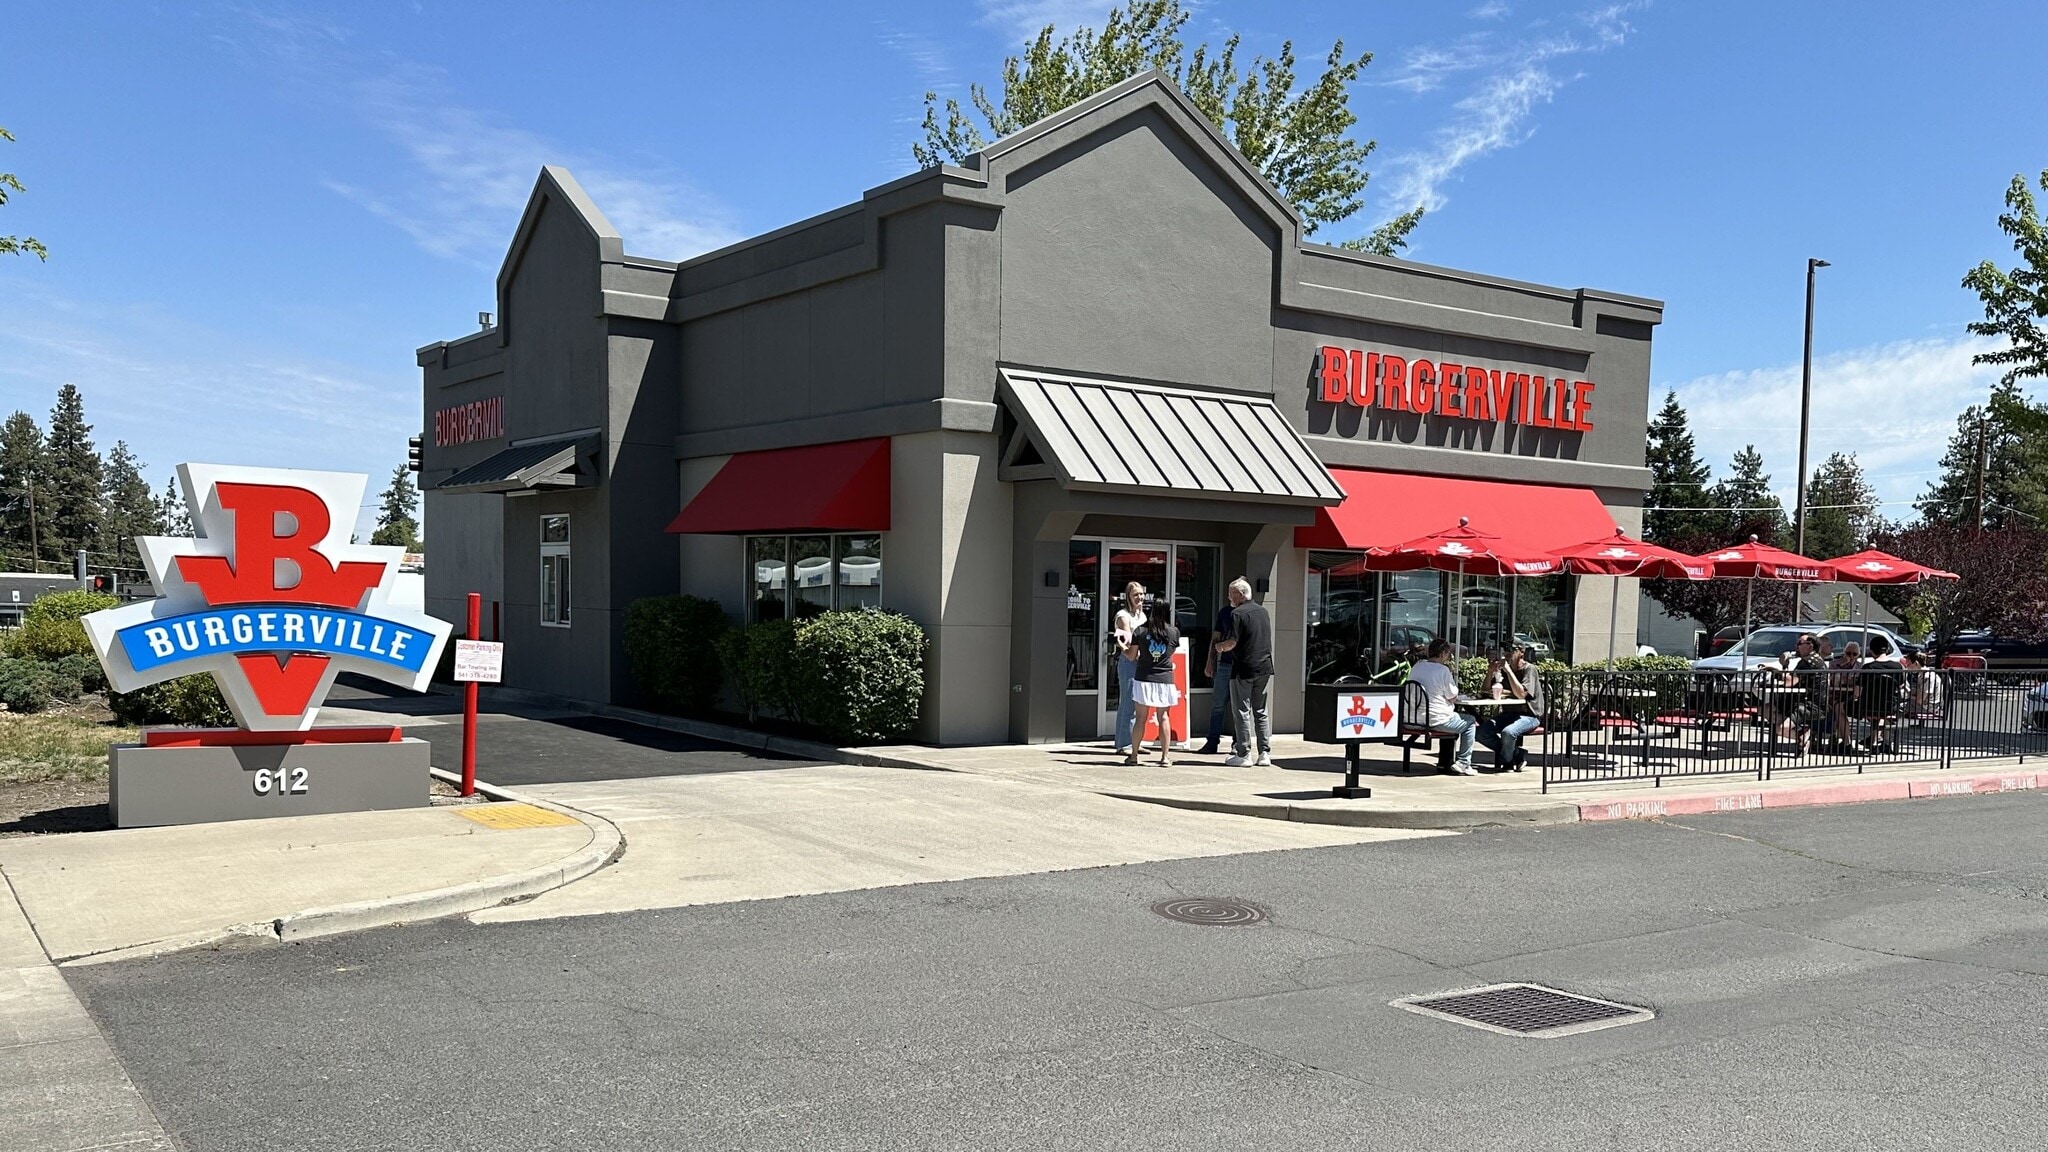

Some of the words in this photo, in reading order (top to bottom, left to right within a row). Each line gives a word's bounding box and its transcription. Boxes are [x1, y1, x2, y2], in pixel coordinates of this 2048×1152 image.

[1317, 346, 1595, 432] BURGERVILLE
[435, 396, 504, 447] BURGERVIL
[1775, 567, 1819, 579] BURGERVILLE
[144, 612, 413, 661] BURGERVILLE
[253, 767, 309, 793] 612
[1930, 783, 1940, 796] NO
[1943, 781, 1973, 795] PARKING
[1607, 803, 1622, 818] NO
[1626, 801, 1667, 816] PARKING
[1715, 796, 1735, 811] FIRE
